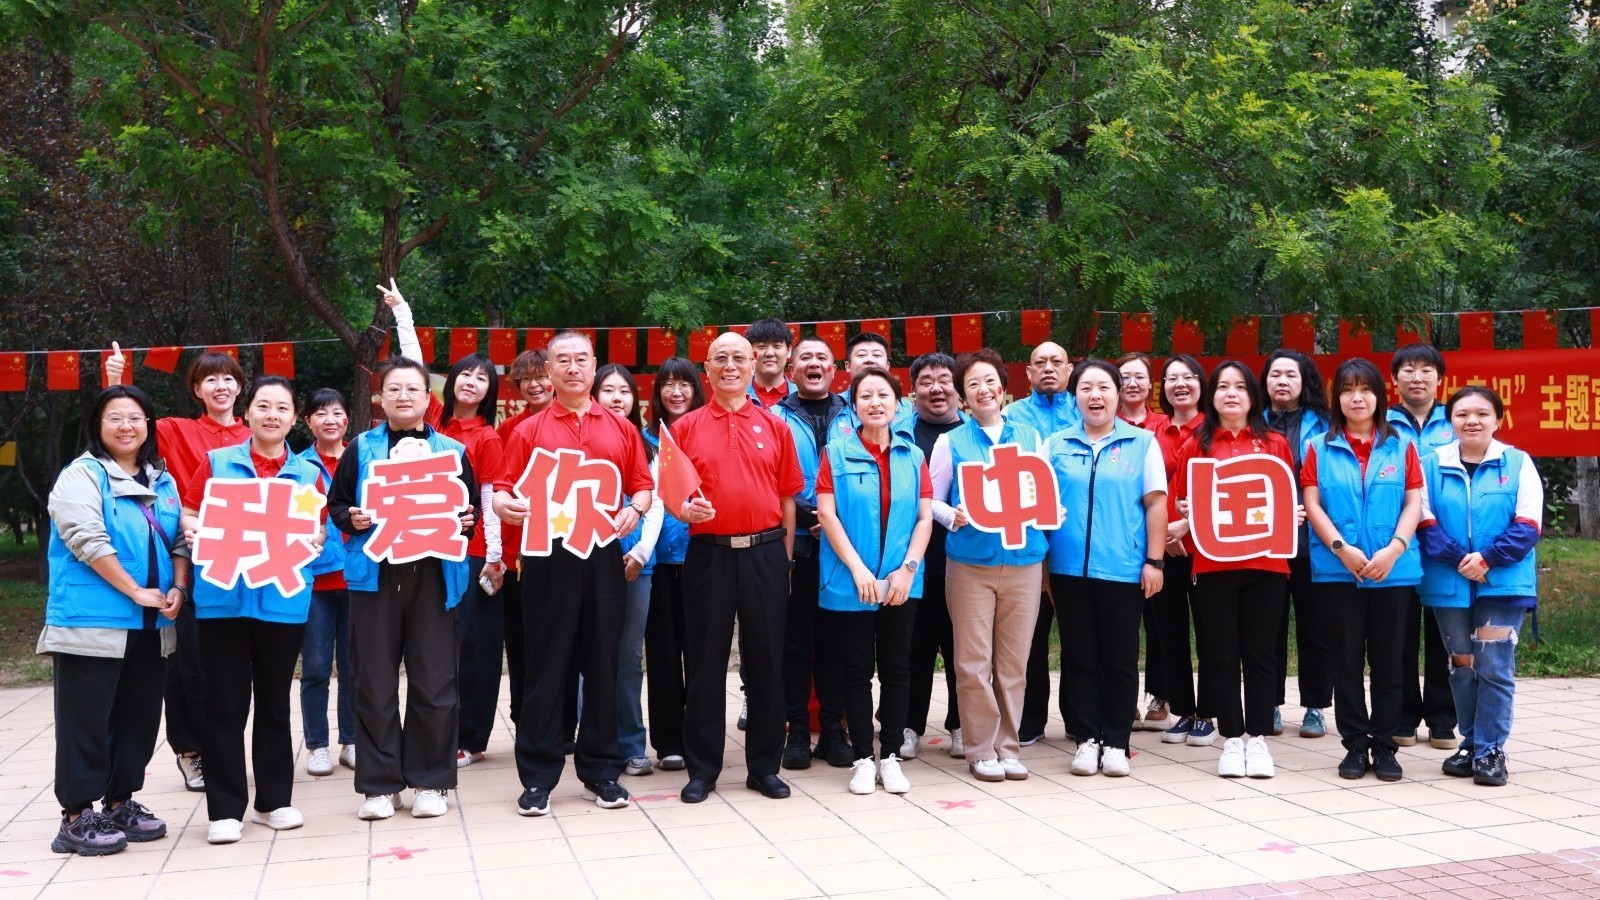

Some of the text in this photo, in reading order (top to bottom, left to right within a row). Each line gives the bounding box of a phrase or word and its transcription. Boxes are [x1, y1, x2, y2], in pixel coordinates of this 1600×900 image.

[197, 482, 325, 594] 我
[365, 453, 466, 560] 爱
[518, 451, 619, 556] 你
[961, 446, 1058, 546] 中
[1191, 458, 1295, 558] 国
